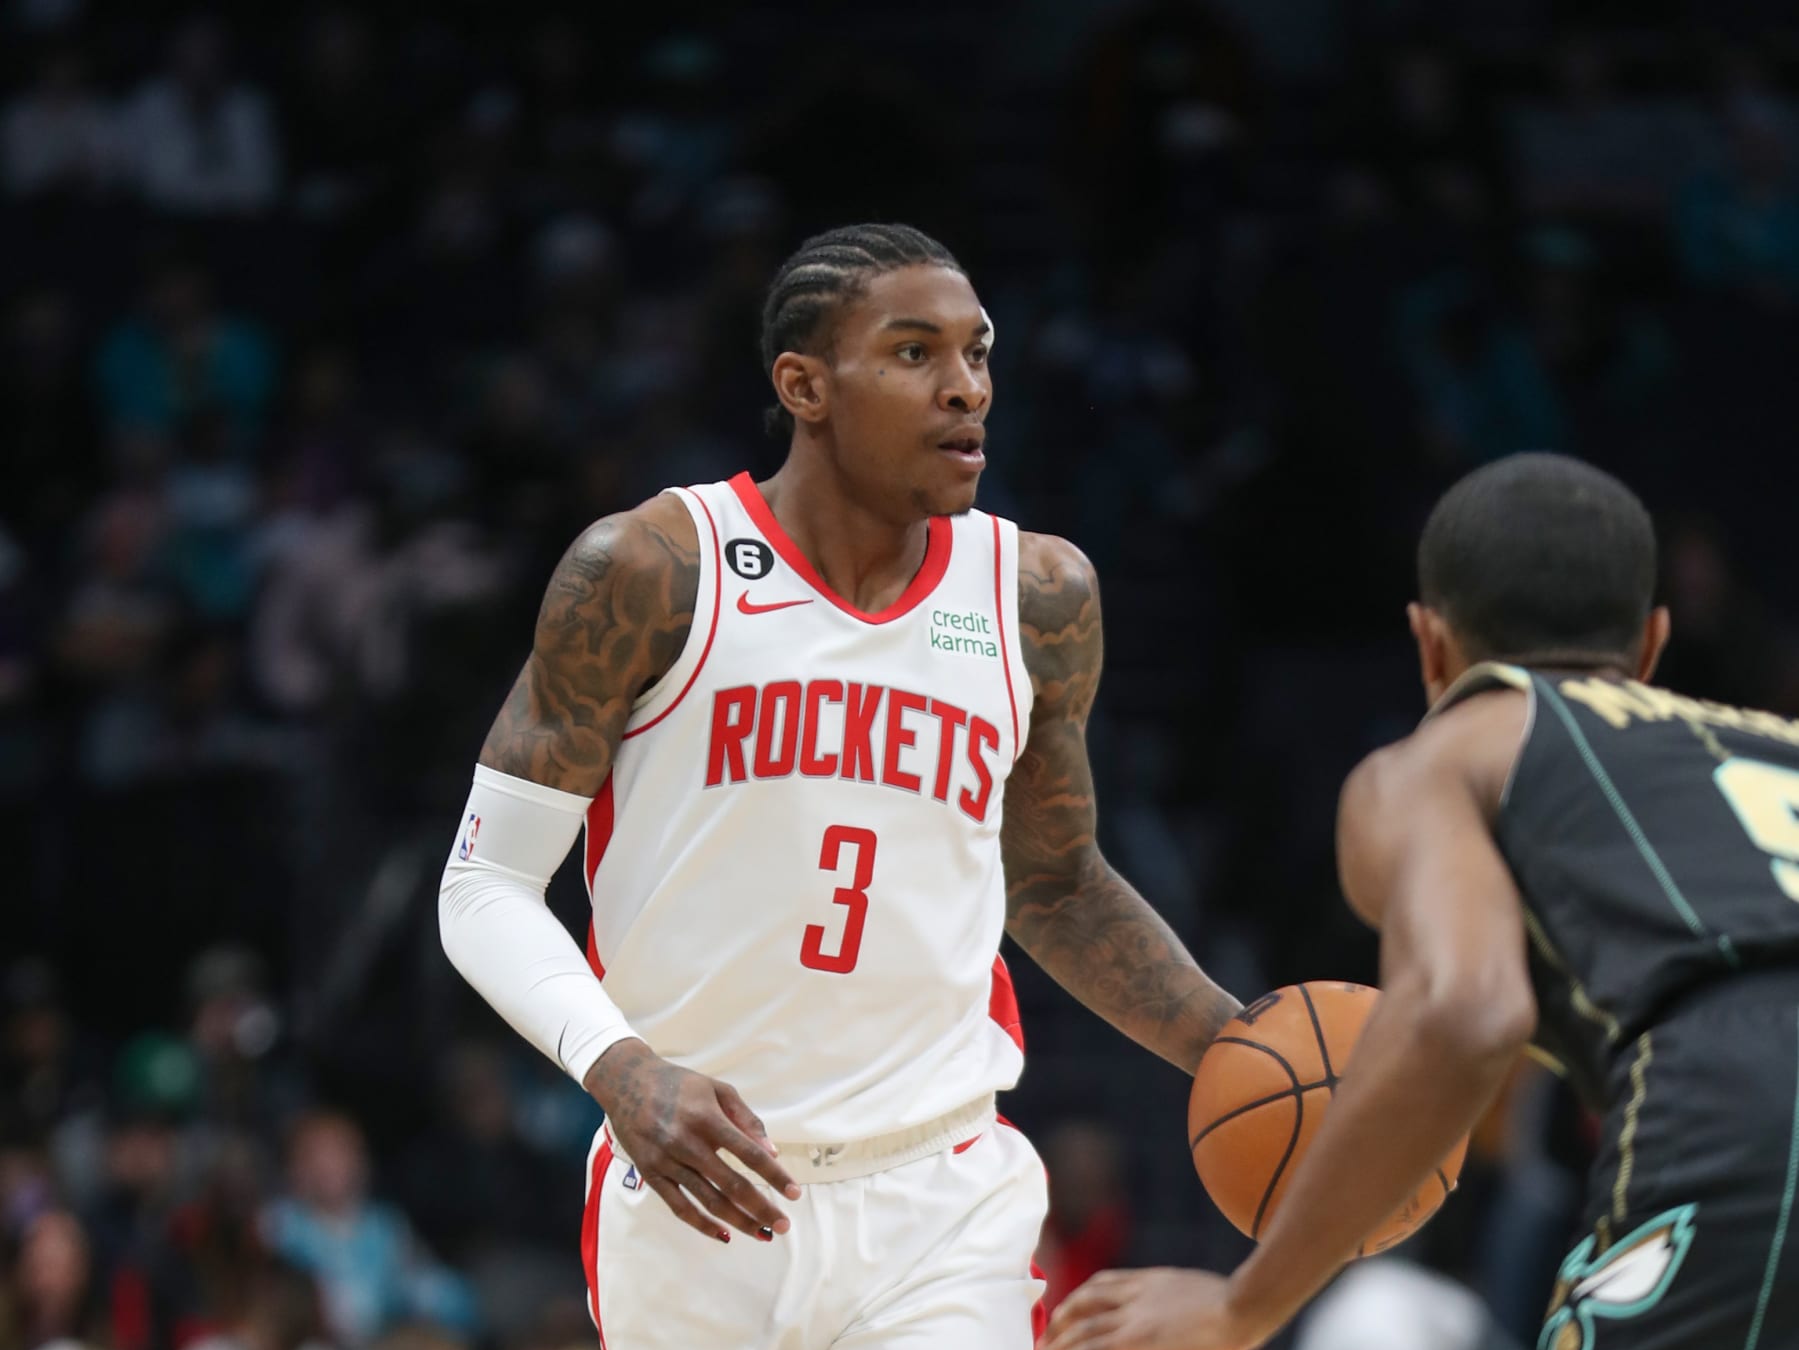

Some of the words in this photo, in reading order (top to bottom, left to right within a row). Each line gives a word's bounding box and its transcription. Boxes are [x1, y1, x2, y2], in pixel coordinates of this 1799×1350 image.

[734, 543, 763, 574] 6
[932, 609, 991, 634] credit
[930, 626, 998, 657] karma
[703, 678, 1002, 825] ROCKETS
[799, 824, 878, 975] 3
